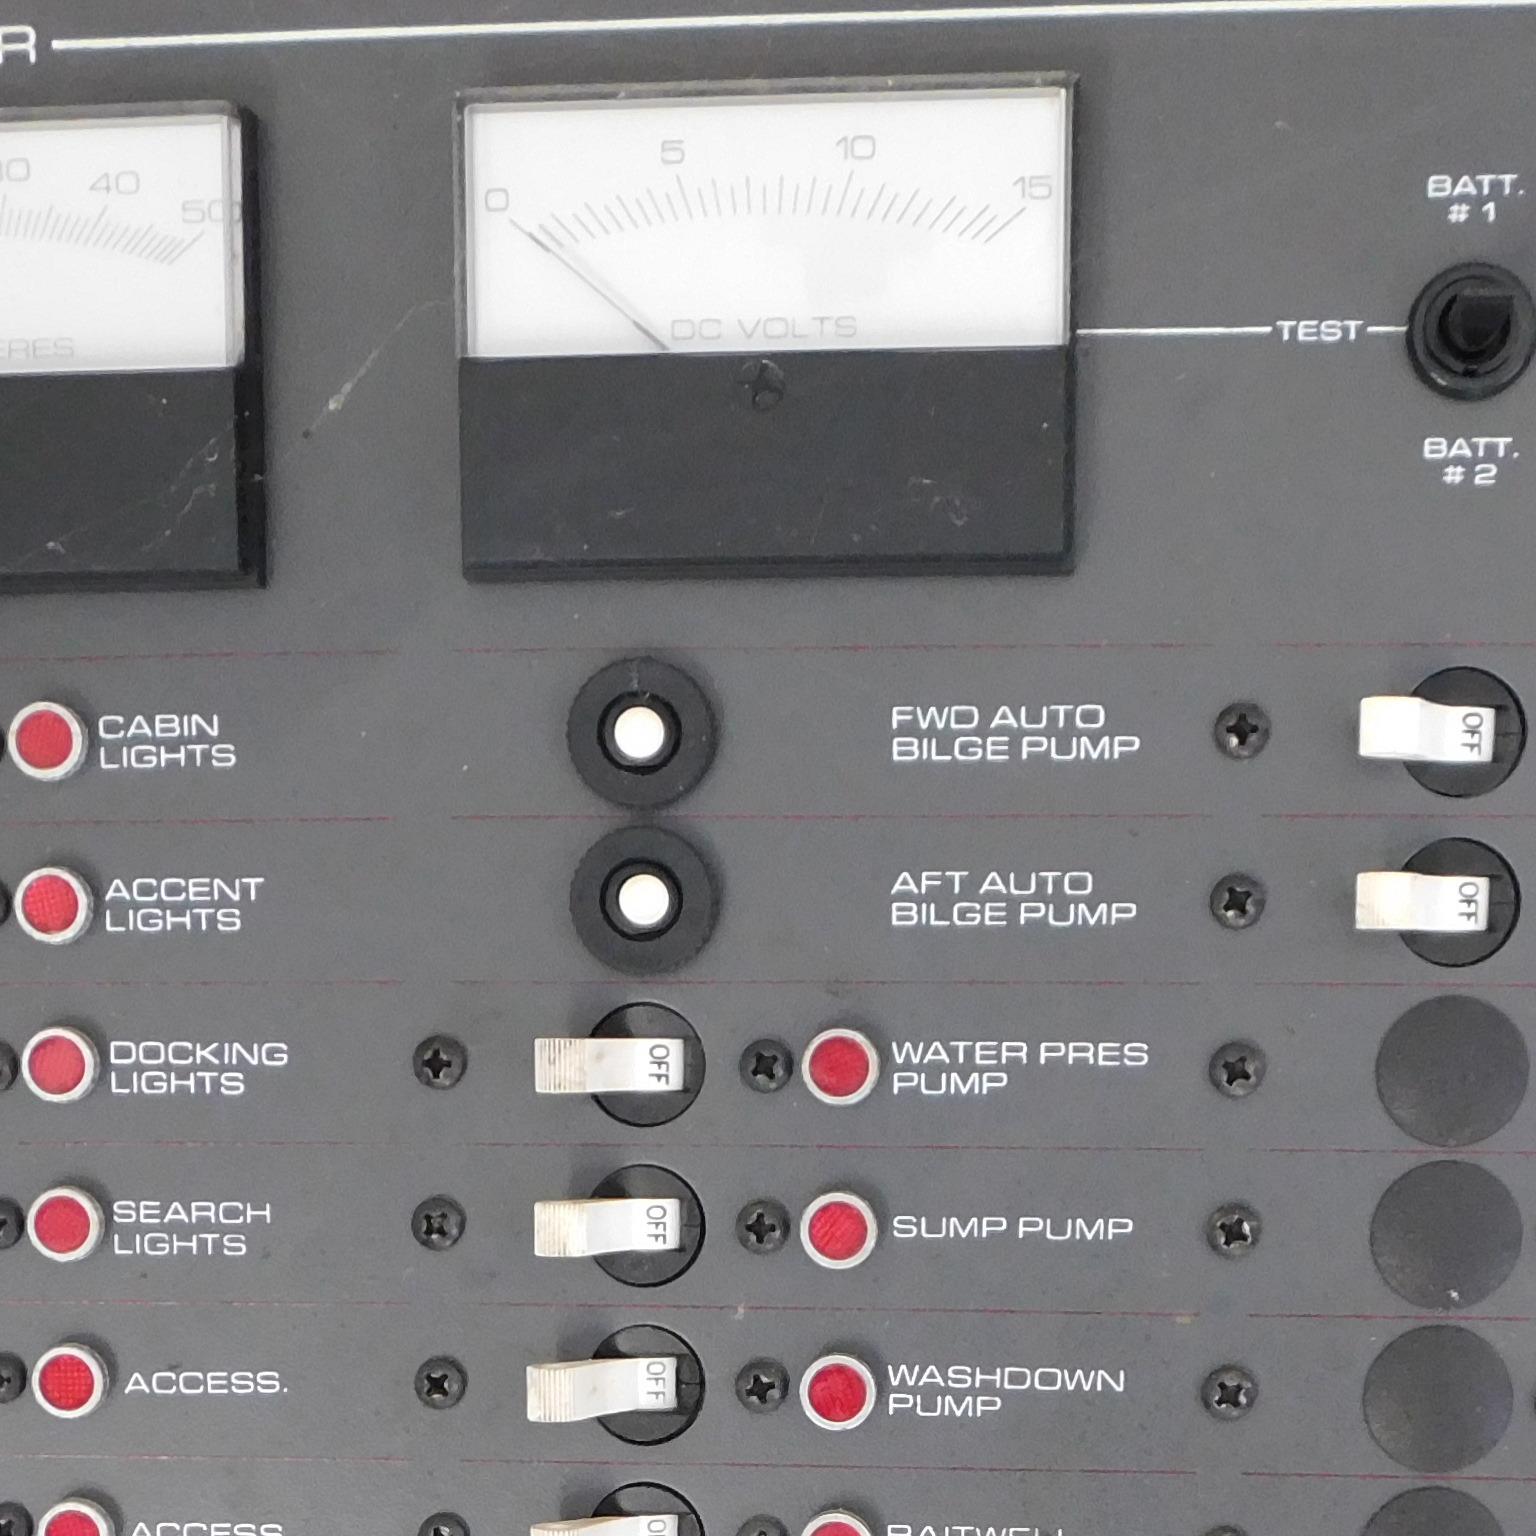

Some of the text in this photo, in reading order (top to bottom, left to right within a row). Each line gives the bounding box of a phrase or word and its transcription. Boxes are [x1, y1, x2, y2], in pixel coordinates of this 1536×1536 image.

[660, 139, 686, 165] 5
[835, 134, 877, 161] 10
[88, 170, 141, 196] 40
[1012, 174, 1054, 201] 15
[1427, 173, 1524, 198] BATT.
[670, 318, 859, 342] DC VOLTS
[1276, 319, 1364, 342] TEST
[1423, 437, 1519, 460] BATT.
[98, 713, 219, 740] CABIN
[891, 704, 1105, 730] FWD AUTO
[1461, 712, 1484, 756] OFF
[99, 743, 237, 770] LIGHTS
[892, 735, 1141, 762] BILGE PUMP
[105, 877, 265, 902] ACCENT
[890, 871, 1093, 896] AFT AUTO
[891, 901, 1137, 927] BILGE PUMP
[1458, 881, 1479, 924] OFF
[105, 908, 242, 932] LIGHTS
[110, 1040, 289, 1067] DOCKING
[648, 1044, 670, 1086] OFF
[891, 1041, 1149, 1066] WATER PRES
[110, 1070, 245, 1096] LIGHTS
[892, 1071, 1008, 1095] PUMP
[113, 1200, 271, 1224] SEARCH
[646, 1204, 668, 1245] OFF
[892, 1215, 1134, 1241] SUMP PUMP
[113, 1232, 247, 1256] LIGHTS
[124, 1371, 288, 1395] ACCESS.
[646, 1361, 667, 1405] OFF
[887, 1364, 1125, 1392] WASHDOWN
[888, 1393, 1002, 1417] PUMP
